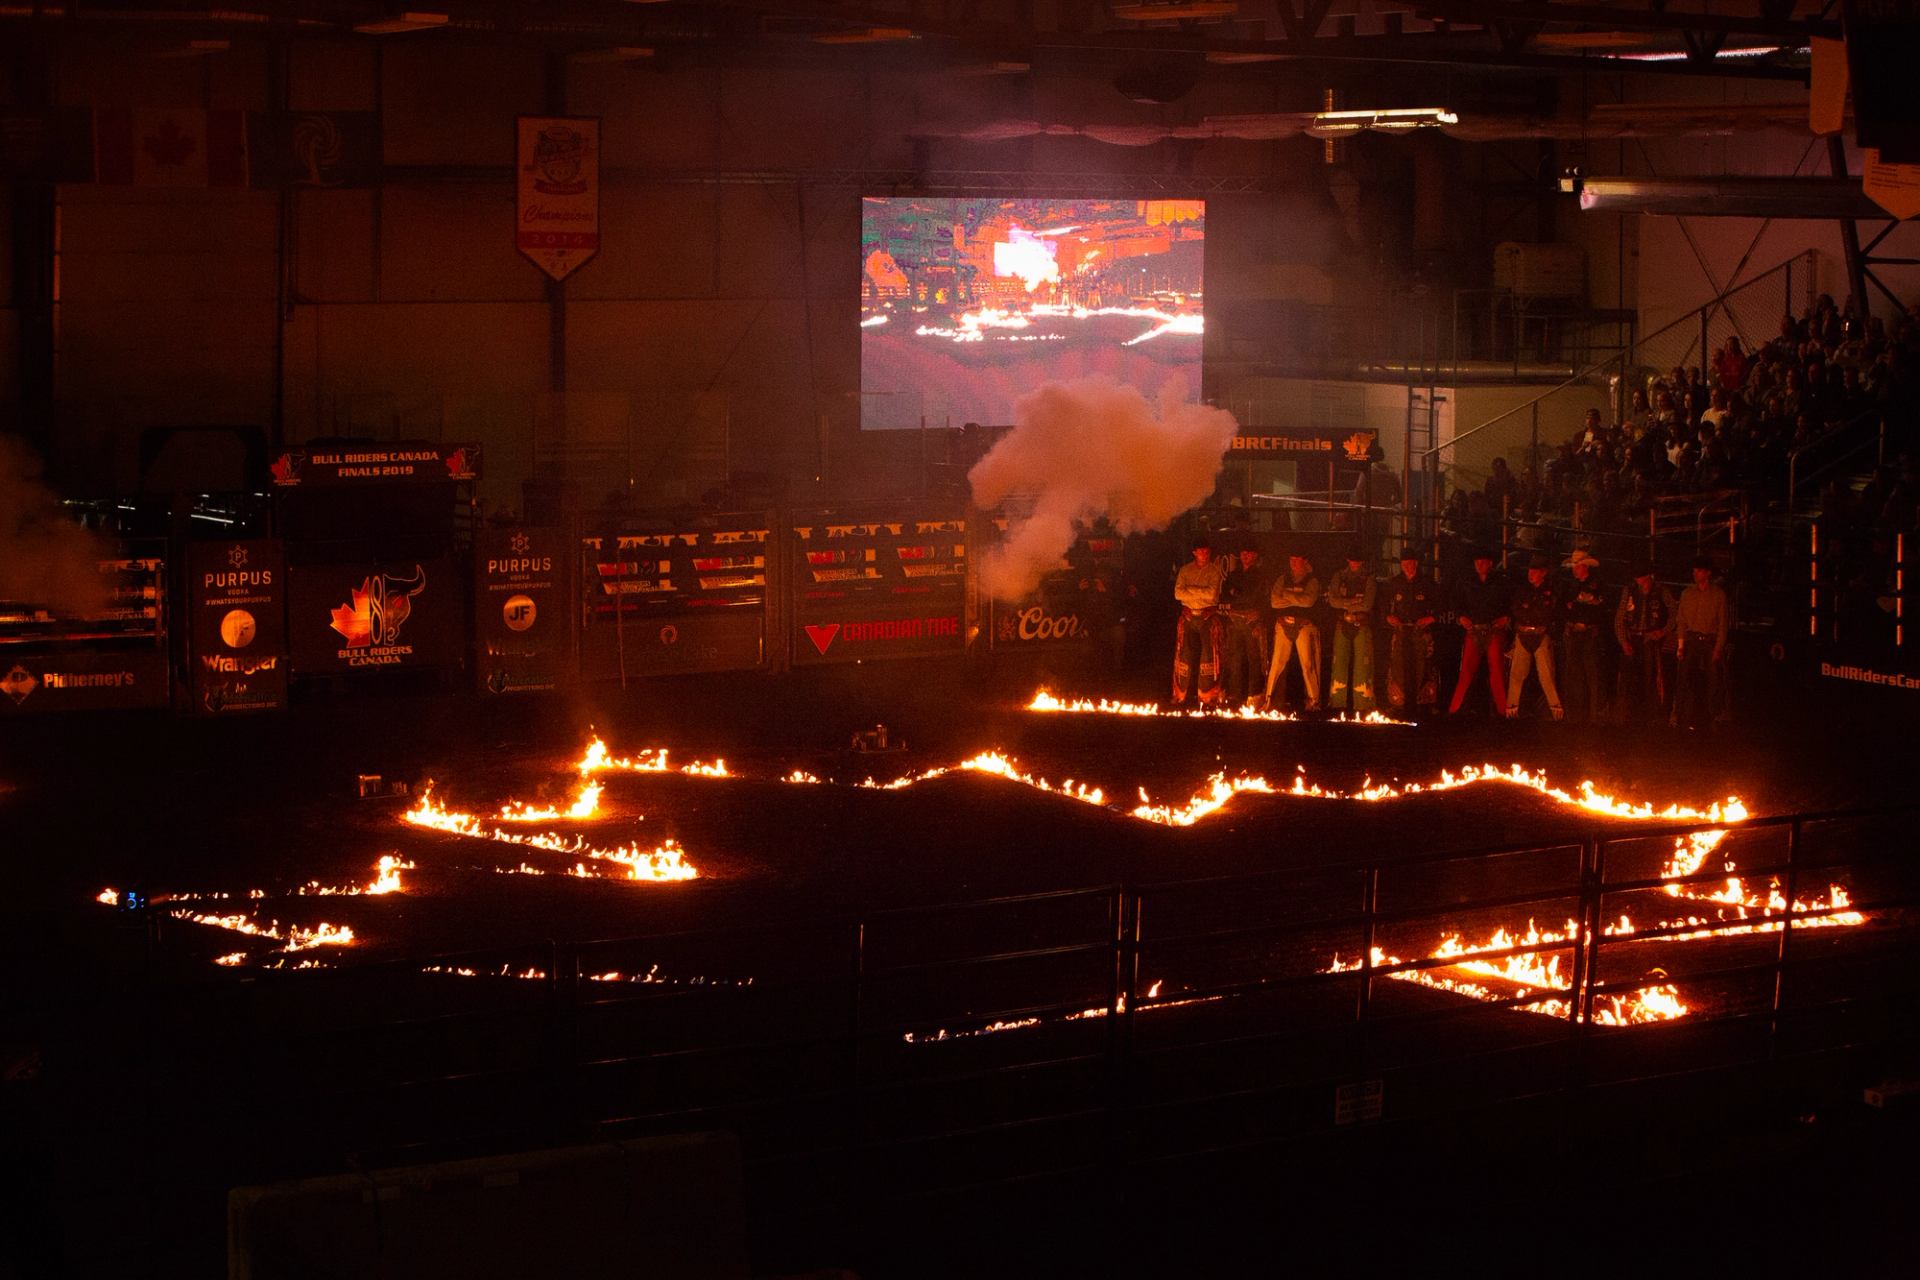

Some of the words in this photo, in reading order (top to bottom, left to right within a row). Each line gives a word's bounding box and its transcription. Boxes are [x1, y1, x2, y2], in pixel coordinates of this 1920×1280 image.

[312, 454, 343, 465] BULL
[344, 452, 388, 464] RIDERS
[389, 451, 439, 462] CANADA
[338, 466, 380, 478] FINALS
[382, 466, 414, 476] 2019
[488, 557, 551, 574] PURPUS
[205, 570, 272, 588] PURPUS
[509, 605, 530, 621] JF
[843, 620, 923, 641] CANADIAN
[925, 616, 959, 637] TIRE
[1017, 606, 1089, 641] Coor
[337, 648, 368, 659] BULL
[369, 645, 413, 657] RIDERS
[349, 655, 402, 666] CANADA
[43, 671, 135, 689] Pidherney's
